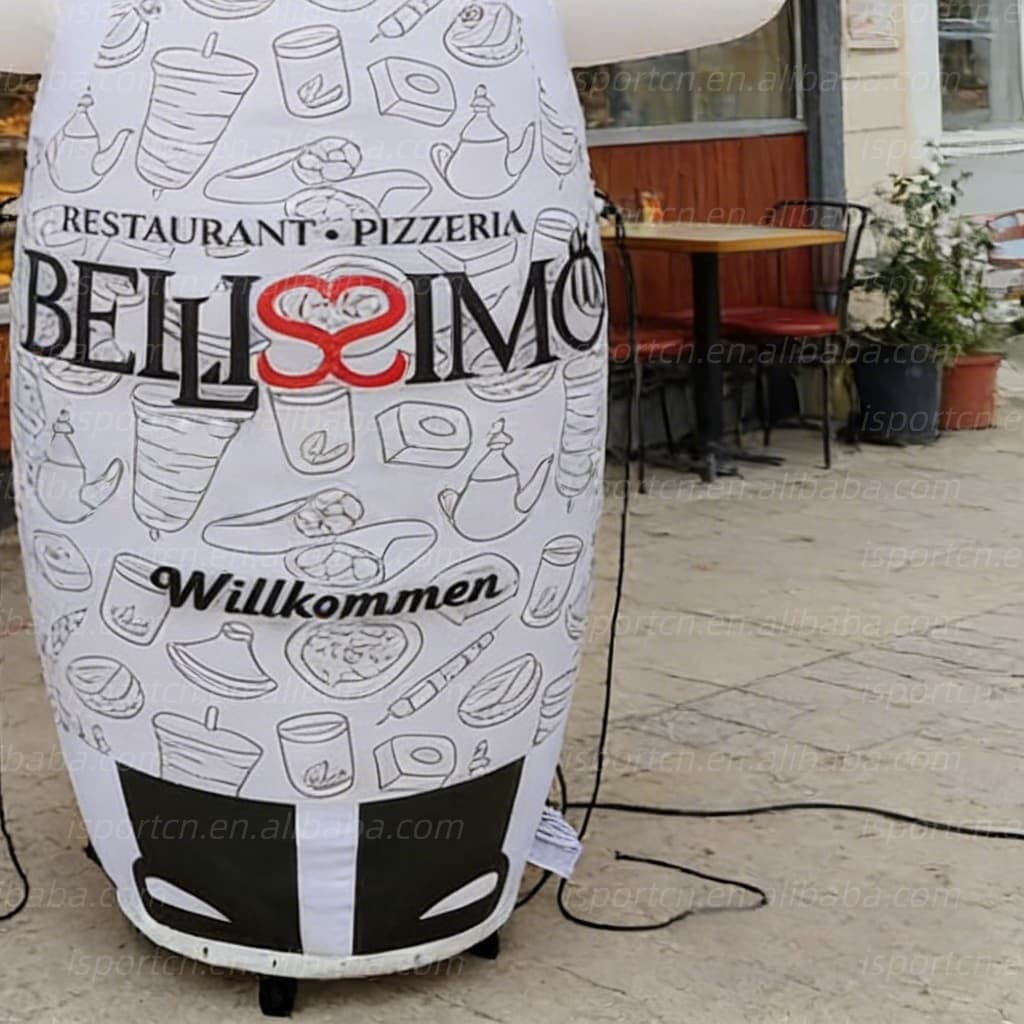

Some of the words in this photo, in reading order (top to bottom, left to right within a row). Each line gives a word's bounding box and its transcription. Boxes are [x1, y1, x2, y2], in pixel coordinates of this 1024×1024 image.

[62, 205, 317, 246] RESTAURANT
[353, 209, 528, 246] PIZZERIA
[150, 565, 502, 620] Willkommen
